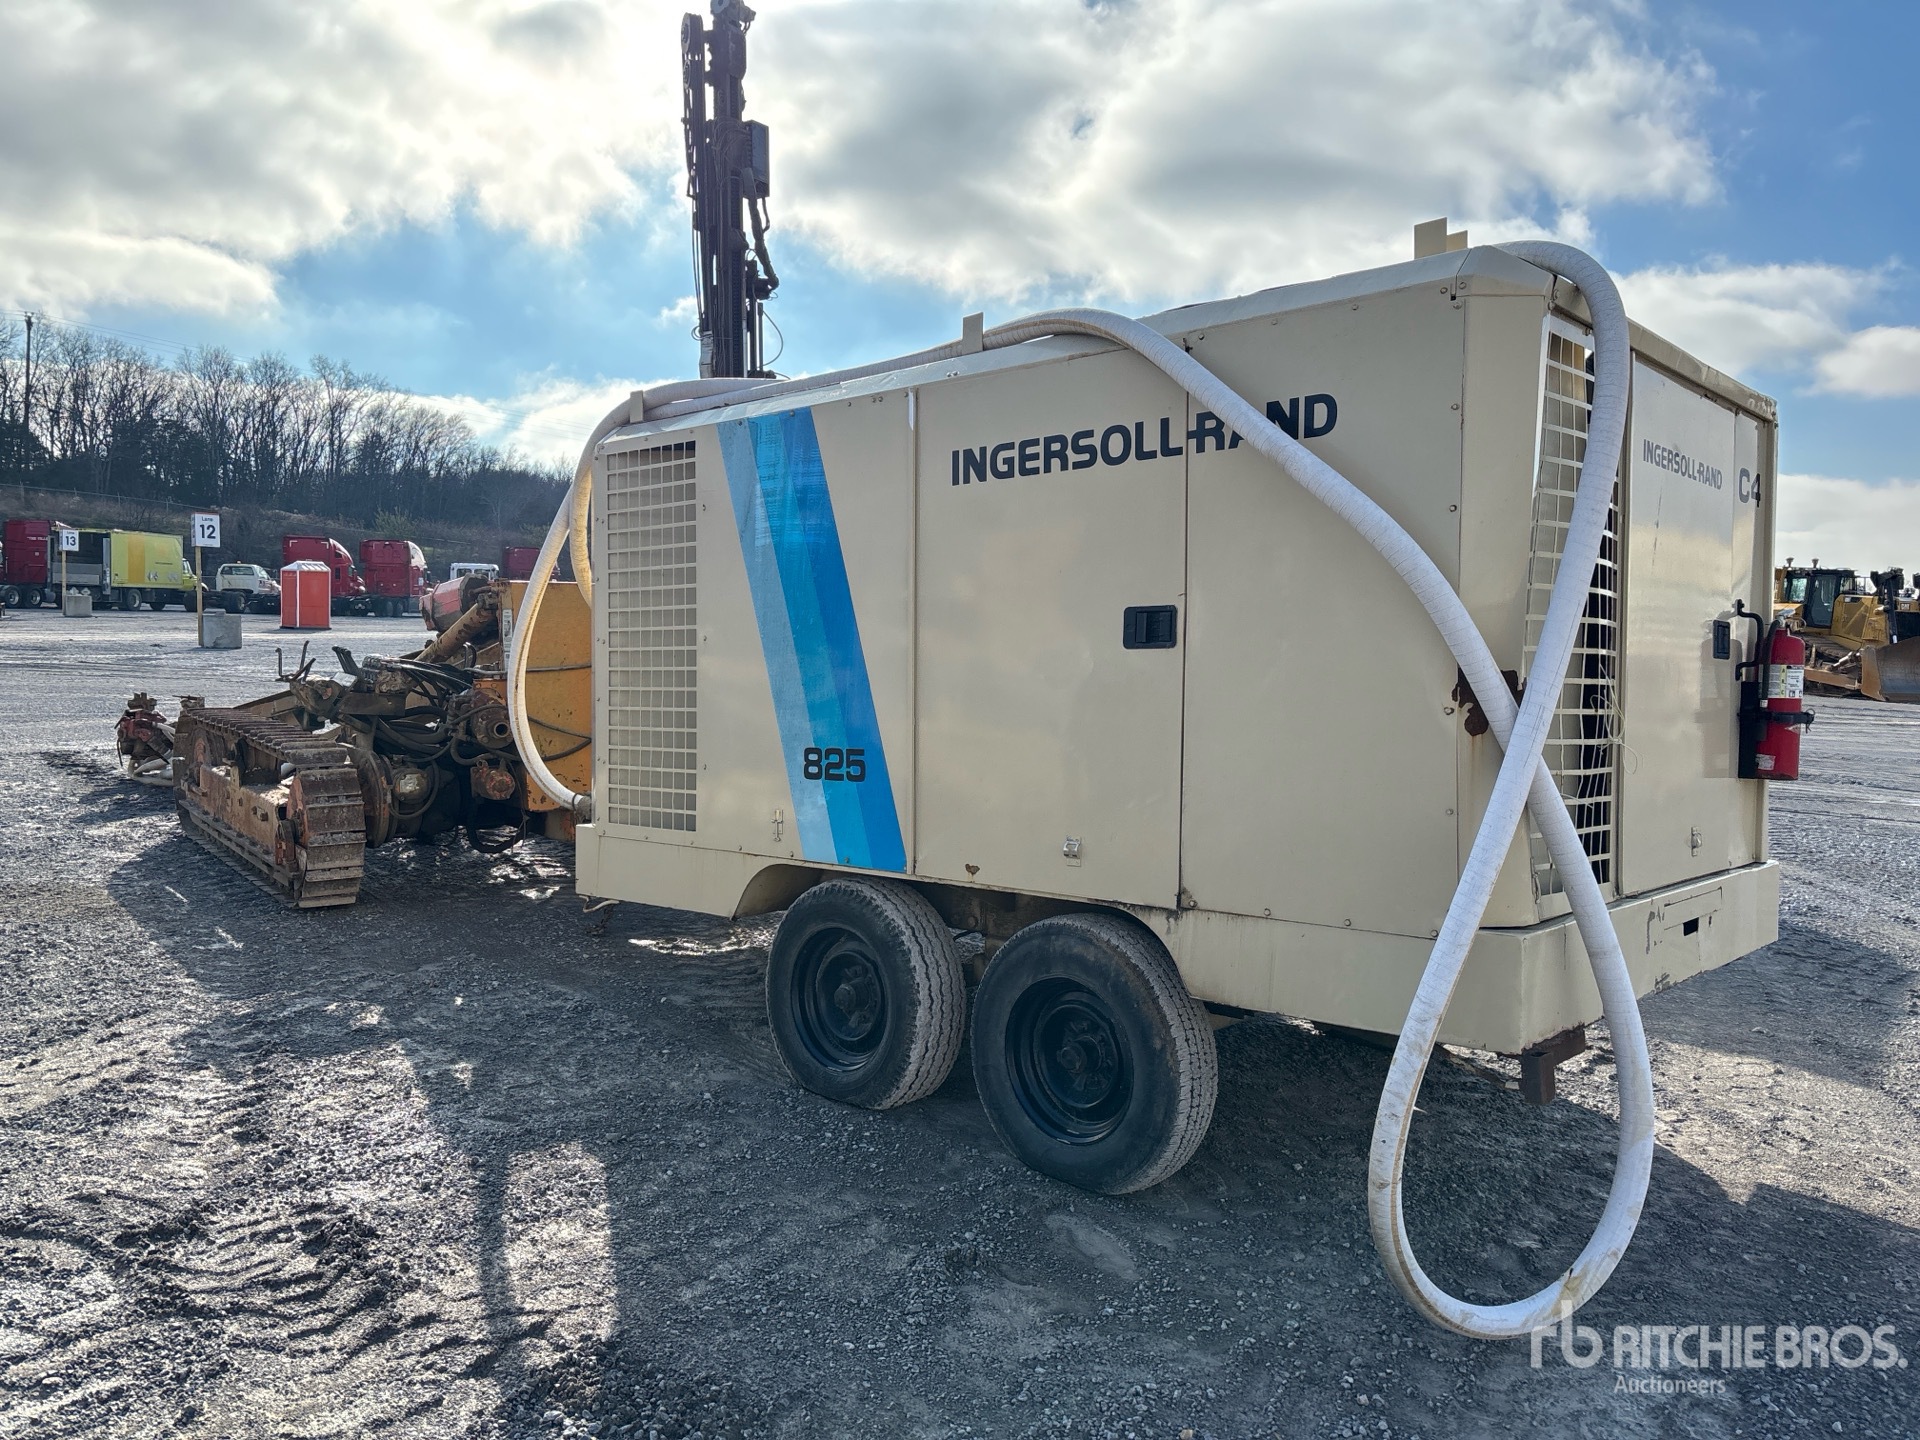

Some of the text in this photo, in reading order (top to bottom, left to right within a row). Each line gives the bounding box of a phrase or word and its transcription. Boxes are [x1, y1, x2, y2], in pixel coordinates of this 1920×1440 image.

[952, 394, 1338, 486] INGERSOLL-RND
[1643, 439, 1723, 490] INGERSOLL-RAND
[1739, 467, 1761, 508] C4
[66, 536, 76, 546] 13
[200, 524, 216, 539] 12
[804, 747, 866, 783] 825
